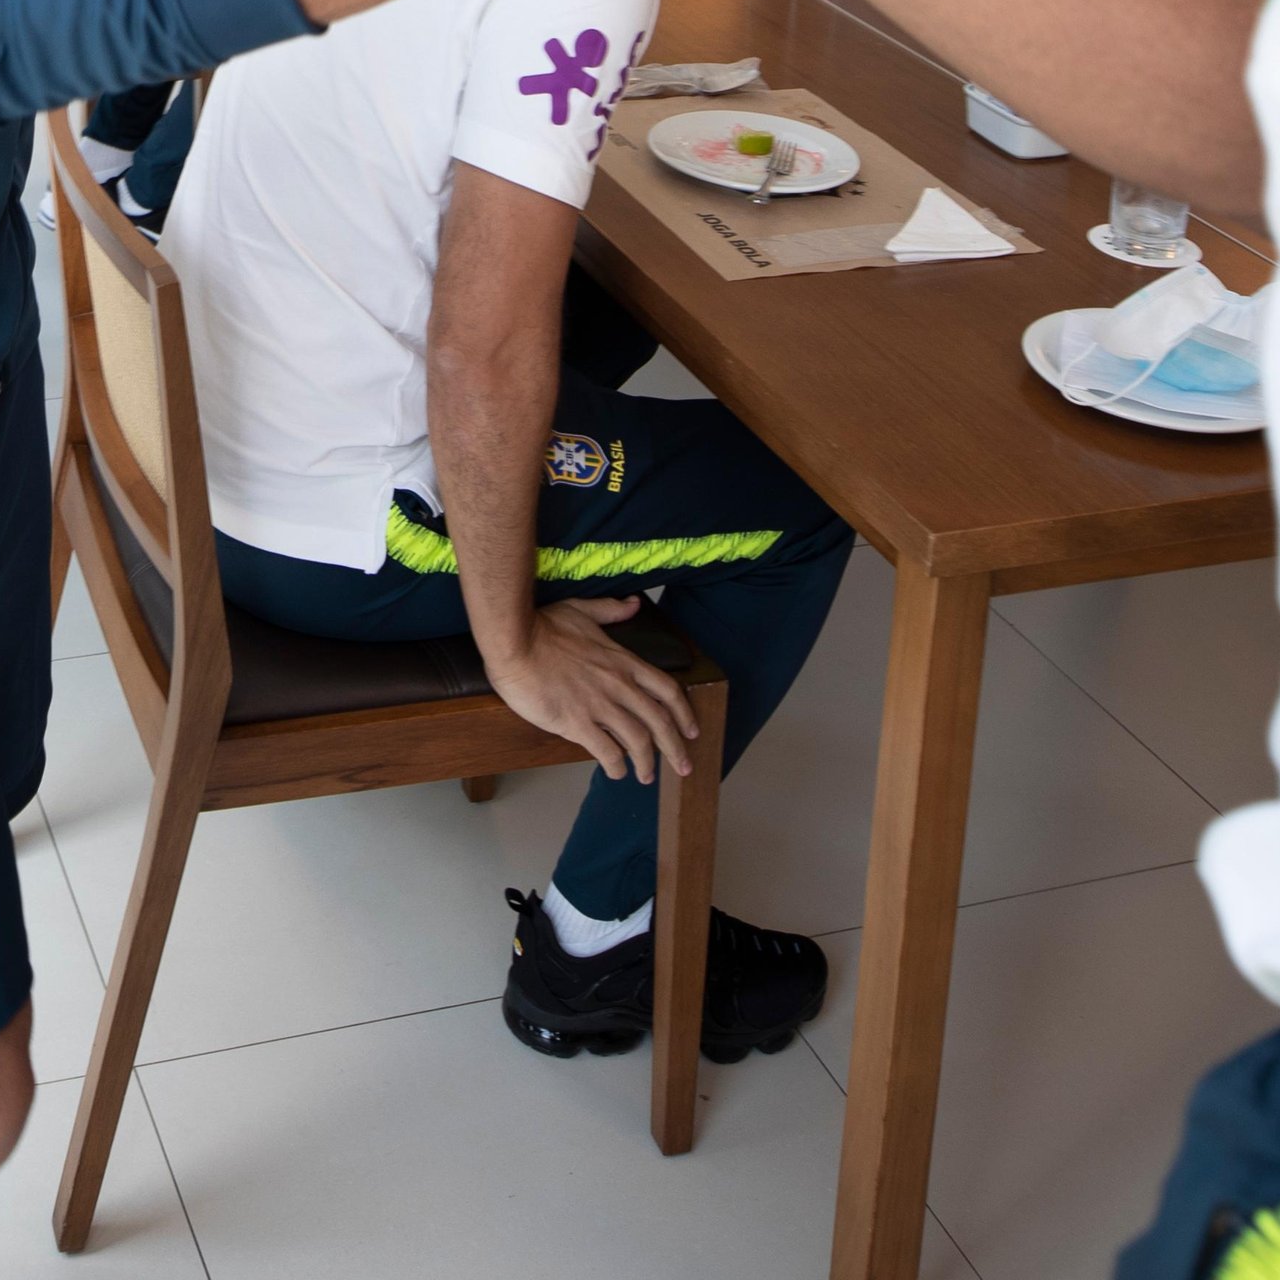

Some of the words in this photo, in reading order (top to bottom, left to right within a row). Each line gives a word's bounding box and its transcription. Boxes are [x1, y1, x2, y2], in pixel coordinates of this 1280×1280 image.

[696, 213, 737, 238] JOGA
[730, 239, 772, 268] BOLA
[607, 439, 625, 493] BRASIL
